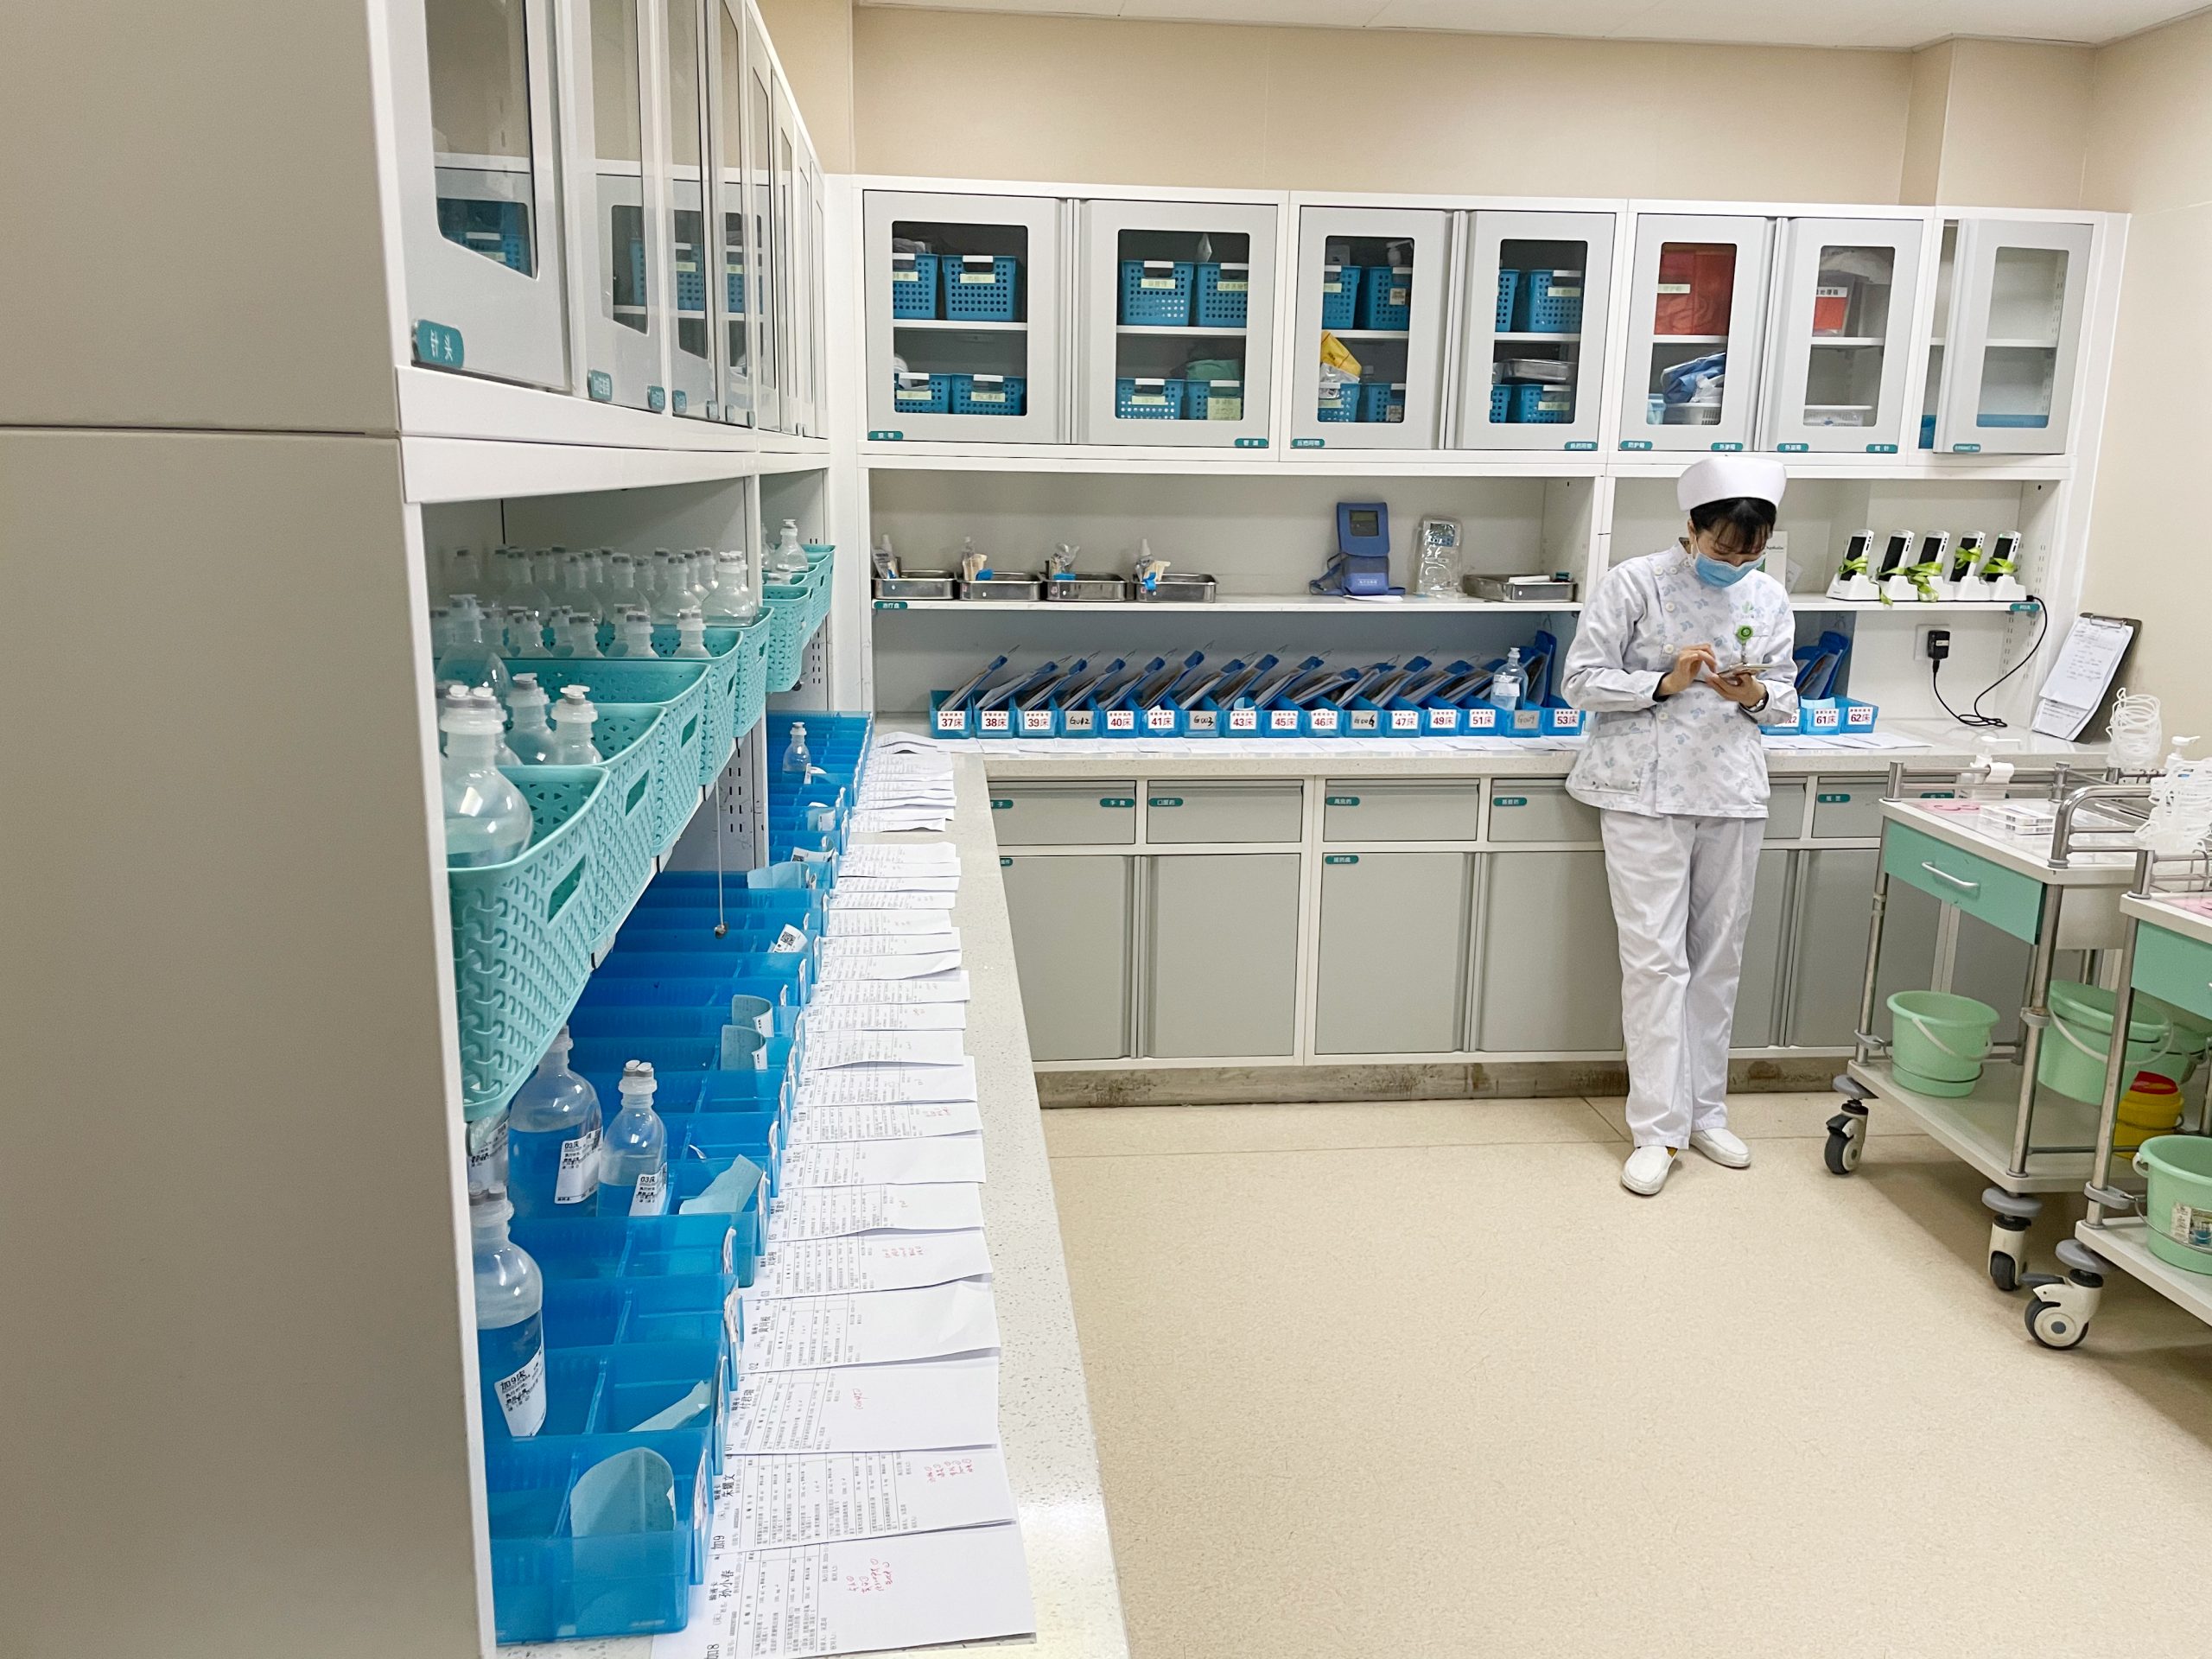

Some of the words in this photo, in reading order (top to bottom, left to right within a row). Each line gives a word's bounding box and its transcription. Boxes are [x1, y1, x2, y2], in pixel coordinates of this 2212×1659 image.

[942, 718, 963, 728] 37床
[985, 718, 1007, 728] 38床
[1027, 718, 1049, 728] 39床
[1110, 718, 1132, 728] 40床
[1151, 717, 1173, 727] 41床
[1232, 717, 1254, 728] 43床
[1274, 718, 1295, 727] 45床
[1313, 717, 1335, 727] 46床
[1395, 717, 1415, 727] 47床
[1433, 715, 1454, 725] 49床
[1472, 715, 1493, 725] 51床
[1557, 715, 1578, 725] 53床
[1815, 715, 1837, 726] 61床
[1850, 714, 1872, 723] 62床
[564, 1141, 579, 1149] 03床
[710, 1535, 725, 1549] 加9
[718, 1569, 734, 1599] 孙小春
